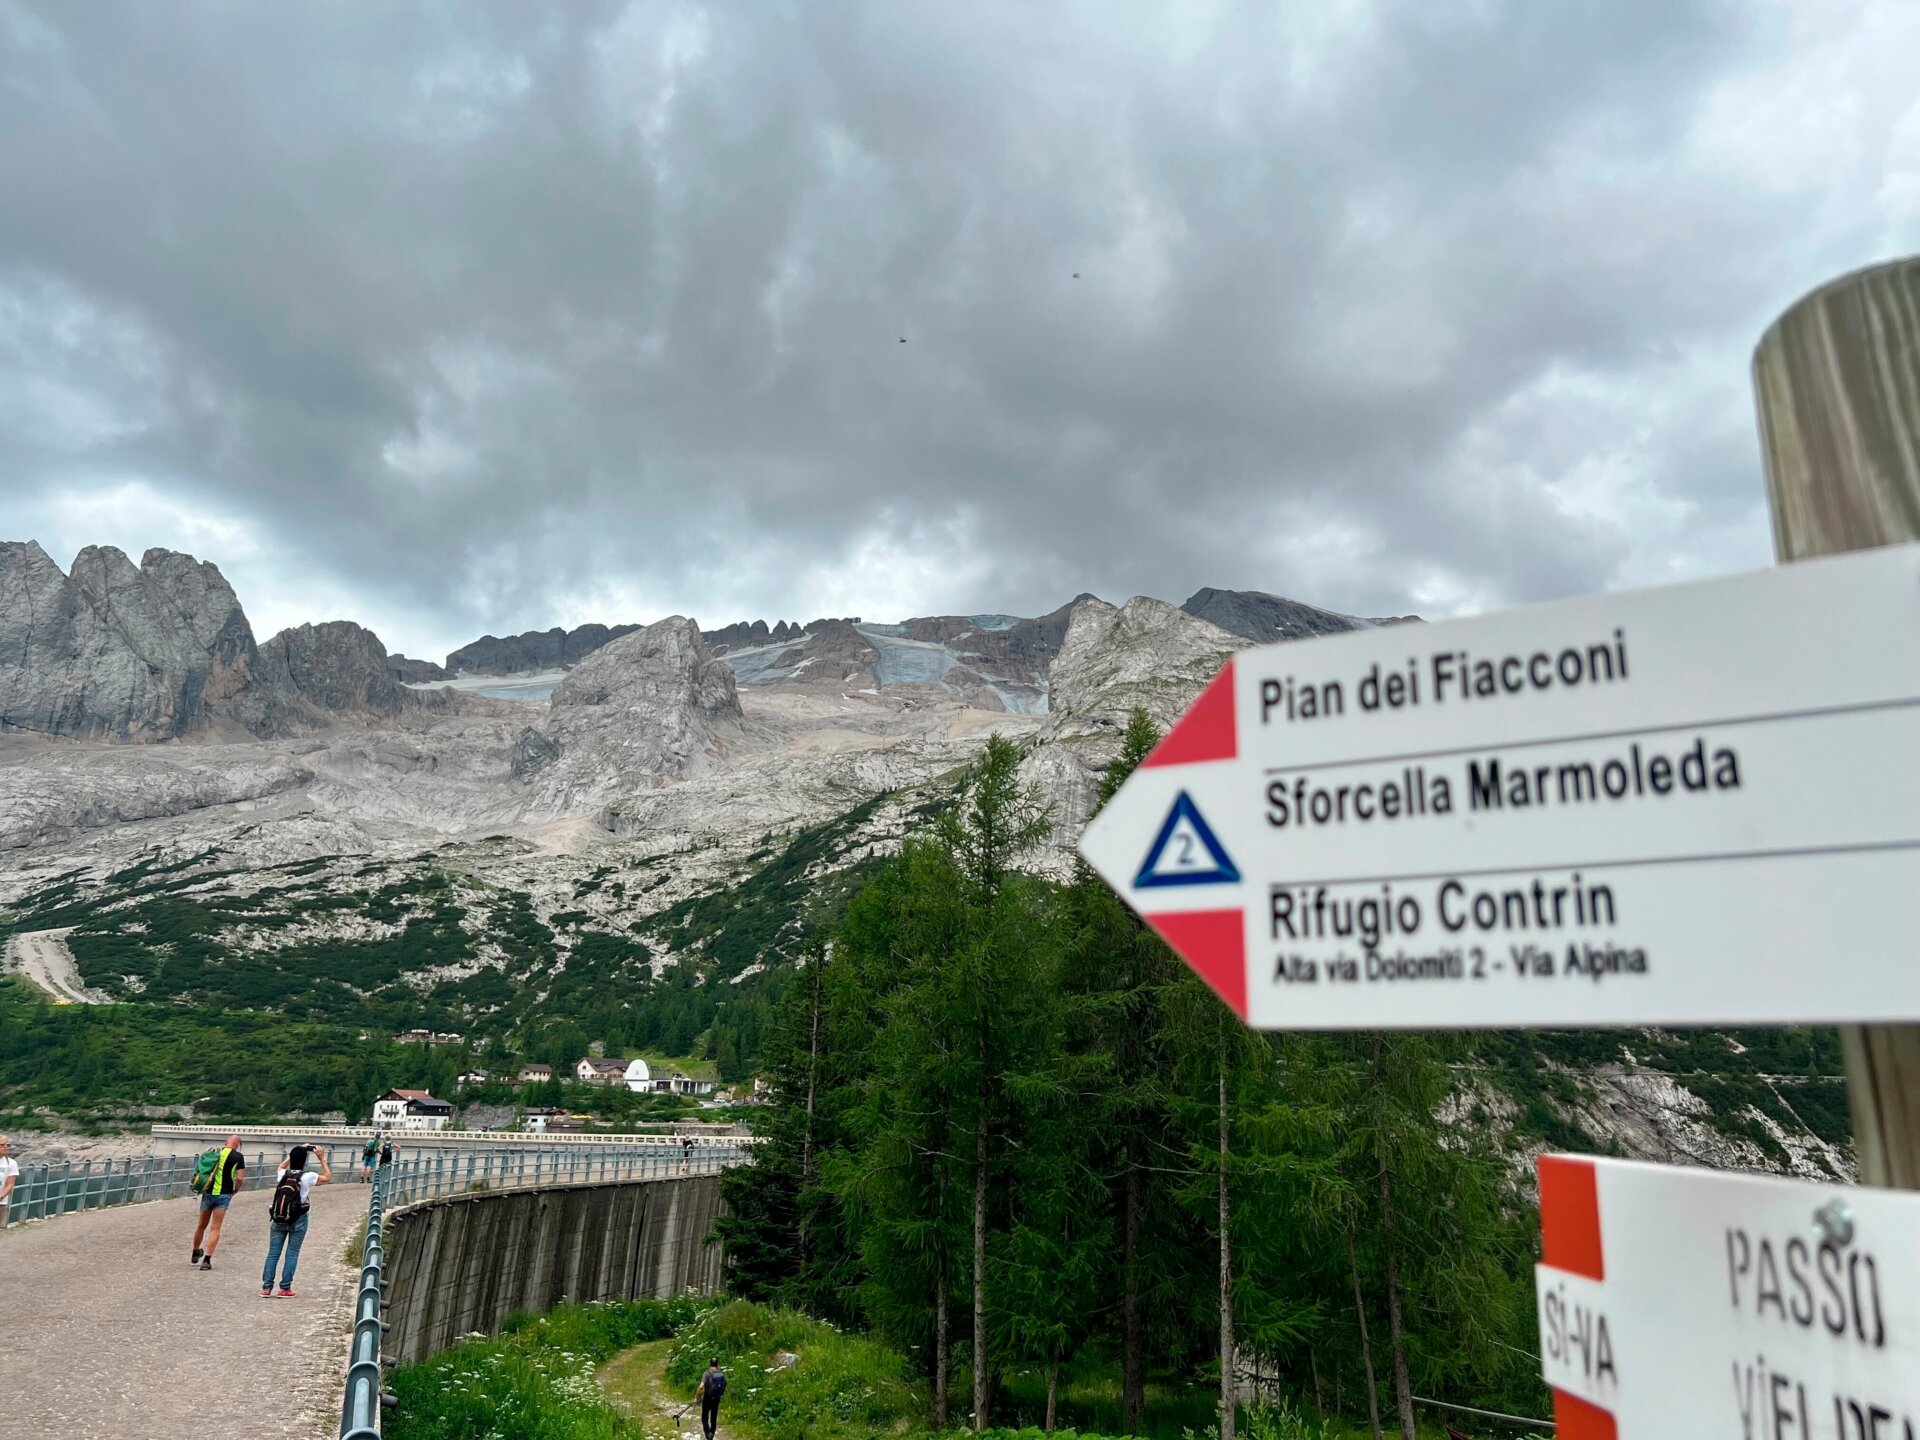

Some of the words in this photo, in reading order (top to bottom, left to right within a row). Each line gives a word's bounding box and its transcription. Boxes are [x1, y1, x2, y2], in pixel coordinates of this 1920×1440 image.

[1260, 676, 1345, 724] Pian
[1357, 662, 1420, 713] dei
[1430, 628, 1629, 703] Fiacconi
[1264, 764, 1453, 828] Sforcella
[1465, 735, 1743, 811] Marmoleda
[1174, 831, 1197, 865] 2
[1269, 882, 1421, 949] Rifugio
[1435, 871, 1617, 933] Contrin
[1273, 951, 1318, 983] Alta
[1325, 951, 1359, 982] via
[1365, 946, 1464, 982] Dolomiti
[1469, 948, 1487, 979] 2
[1508, 944, 1555, 977] Via
[1563, 940, 1650, 983] Alpina
[1725, 1227, 1887, 1350] PASSO
